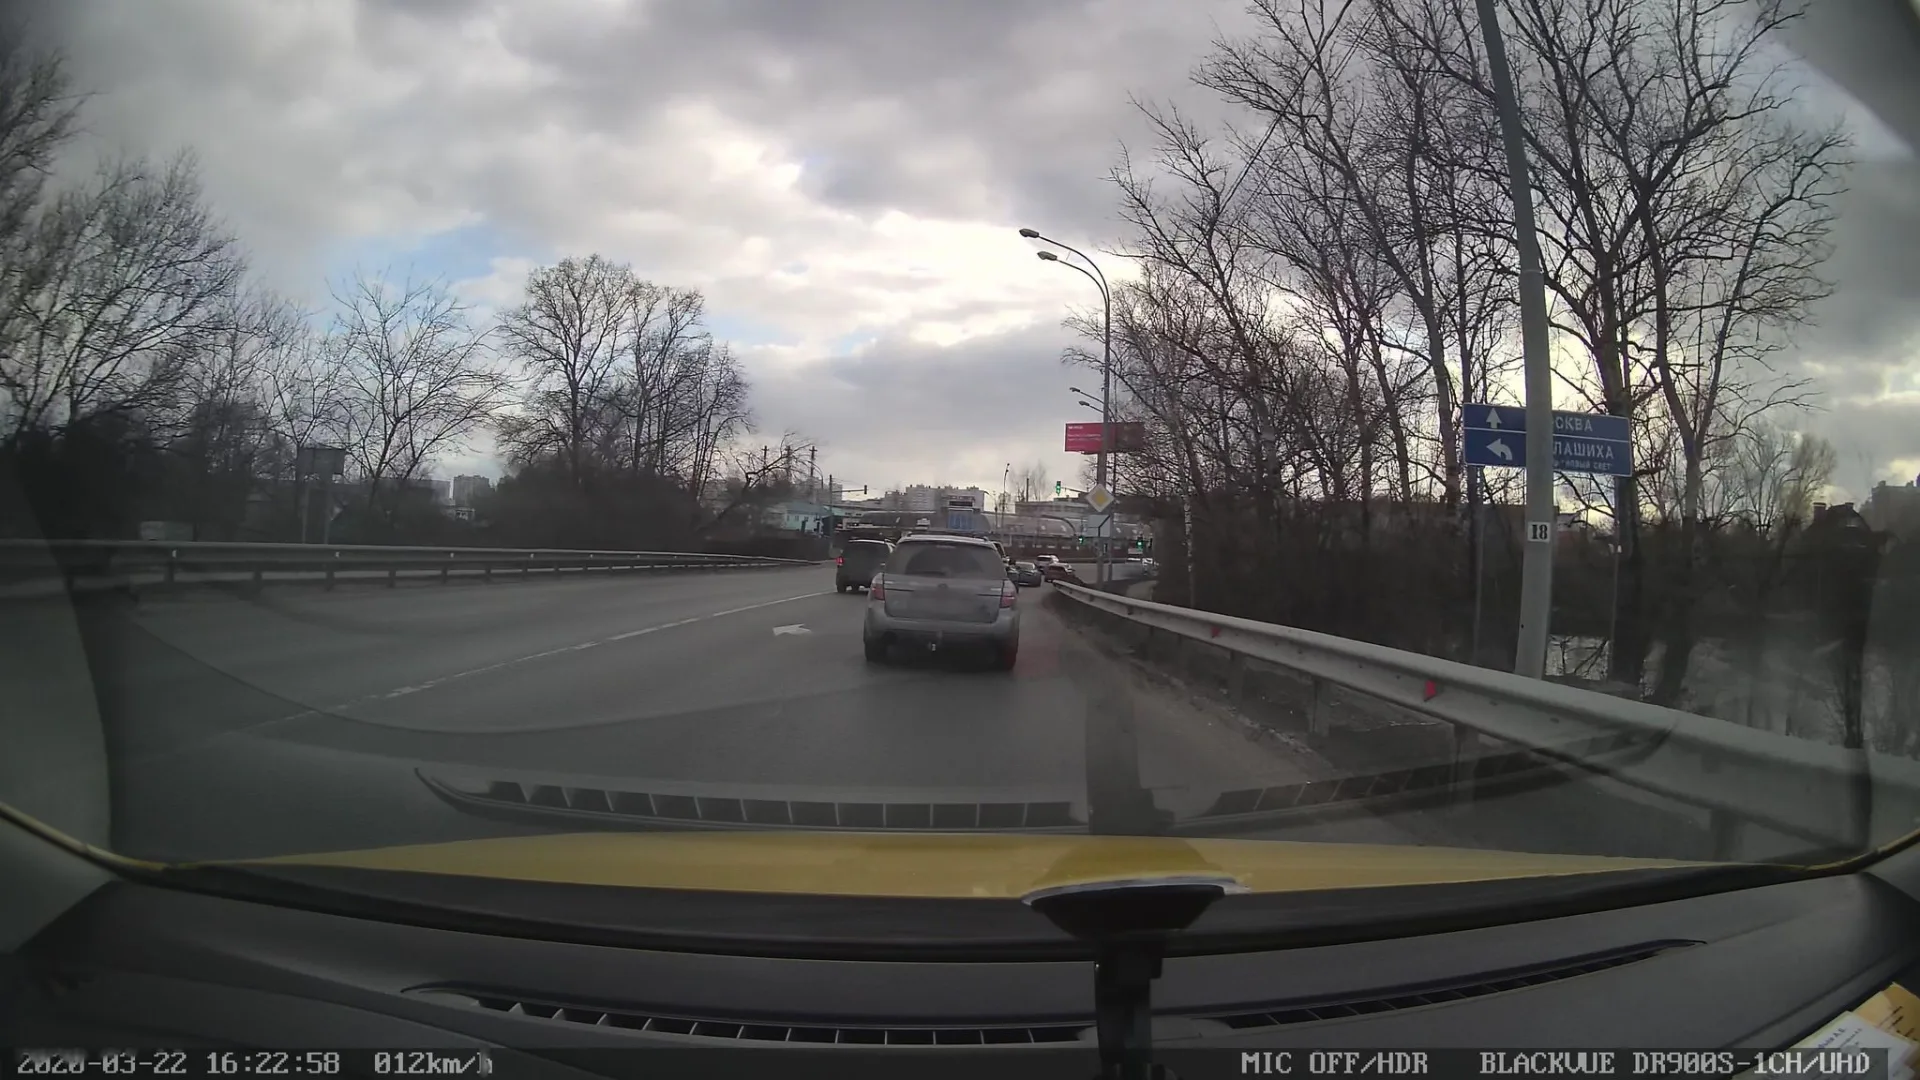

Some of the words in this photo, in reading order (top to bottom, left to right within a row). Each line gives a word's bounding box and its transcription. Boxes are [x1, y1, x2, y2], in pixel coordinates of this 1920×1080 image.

[1552, 416, 1593, 432] СКВА
[1553, 441, 1614, 460] ЛАШИХА
[1531, 524, 1548, 540] 18
